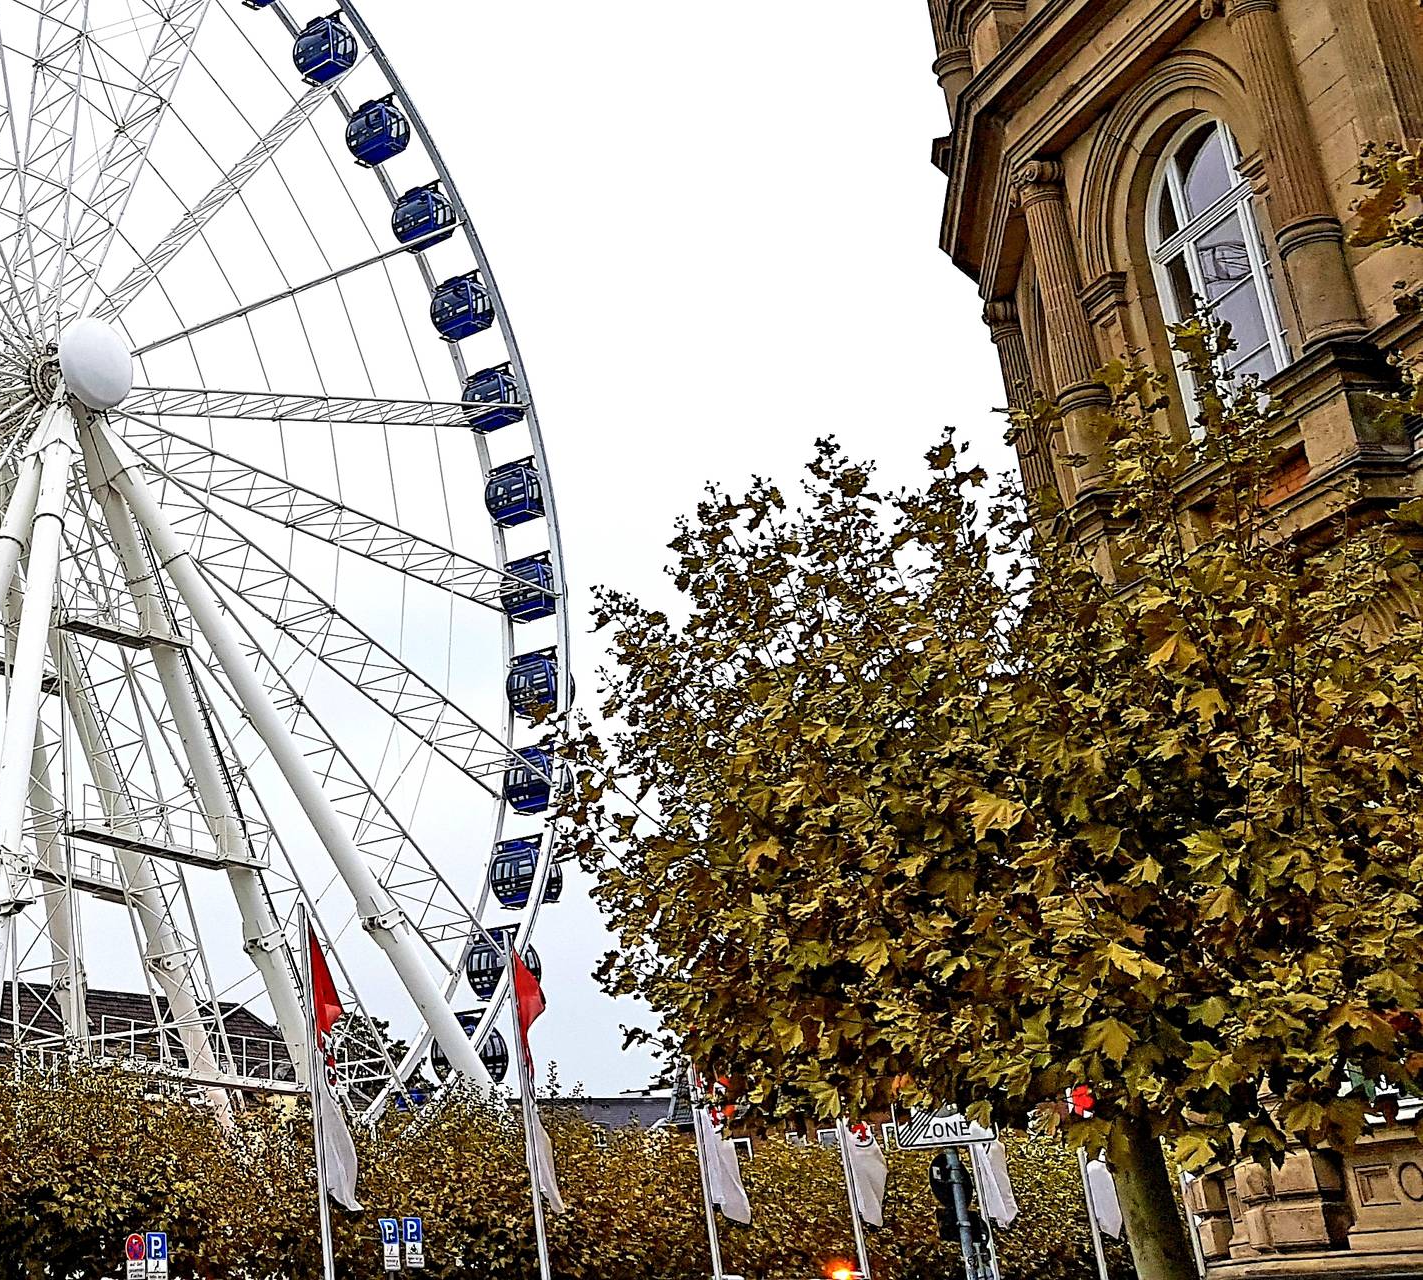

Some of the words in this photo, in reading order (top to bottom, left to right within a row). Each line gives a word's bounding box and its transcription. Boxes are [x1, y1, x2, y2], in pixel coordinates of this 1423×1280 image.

[922, 1121, 971, 1139] ZONE
[383, 1221, 394, 1240] P
[407, 1221, 417, 1240] P
[151, 1236, 162, 1257] P
